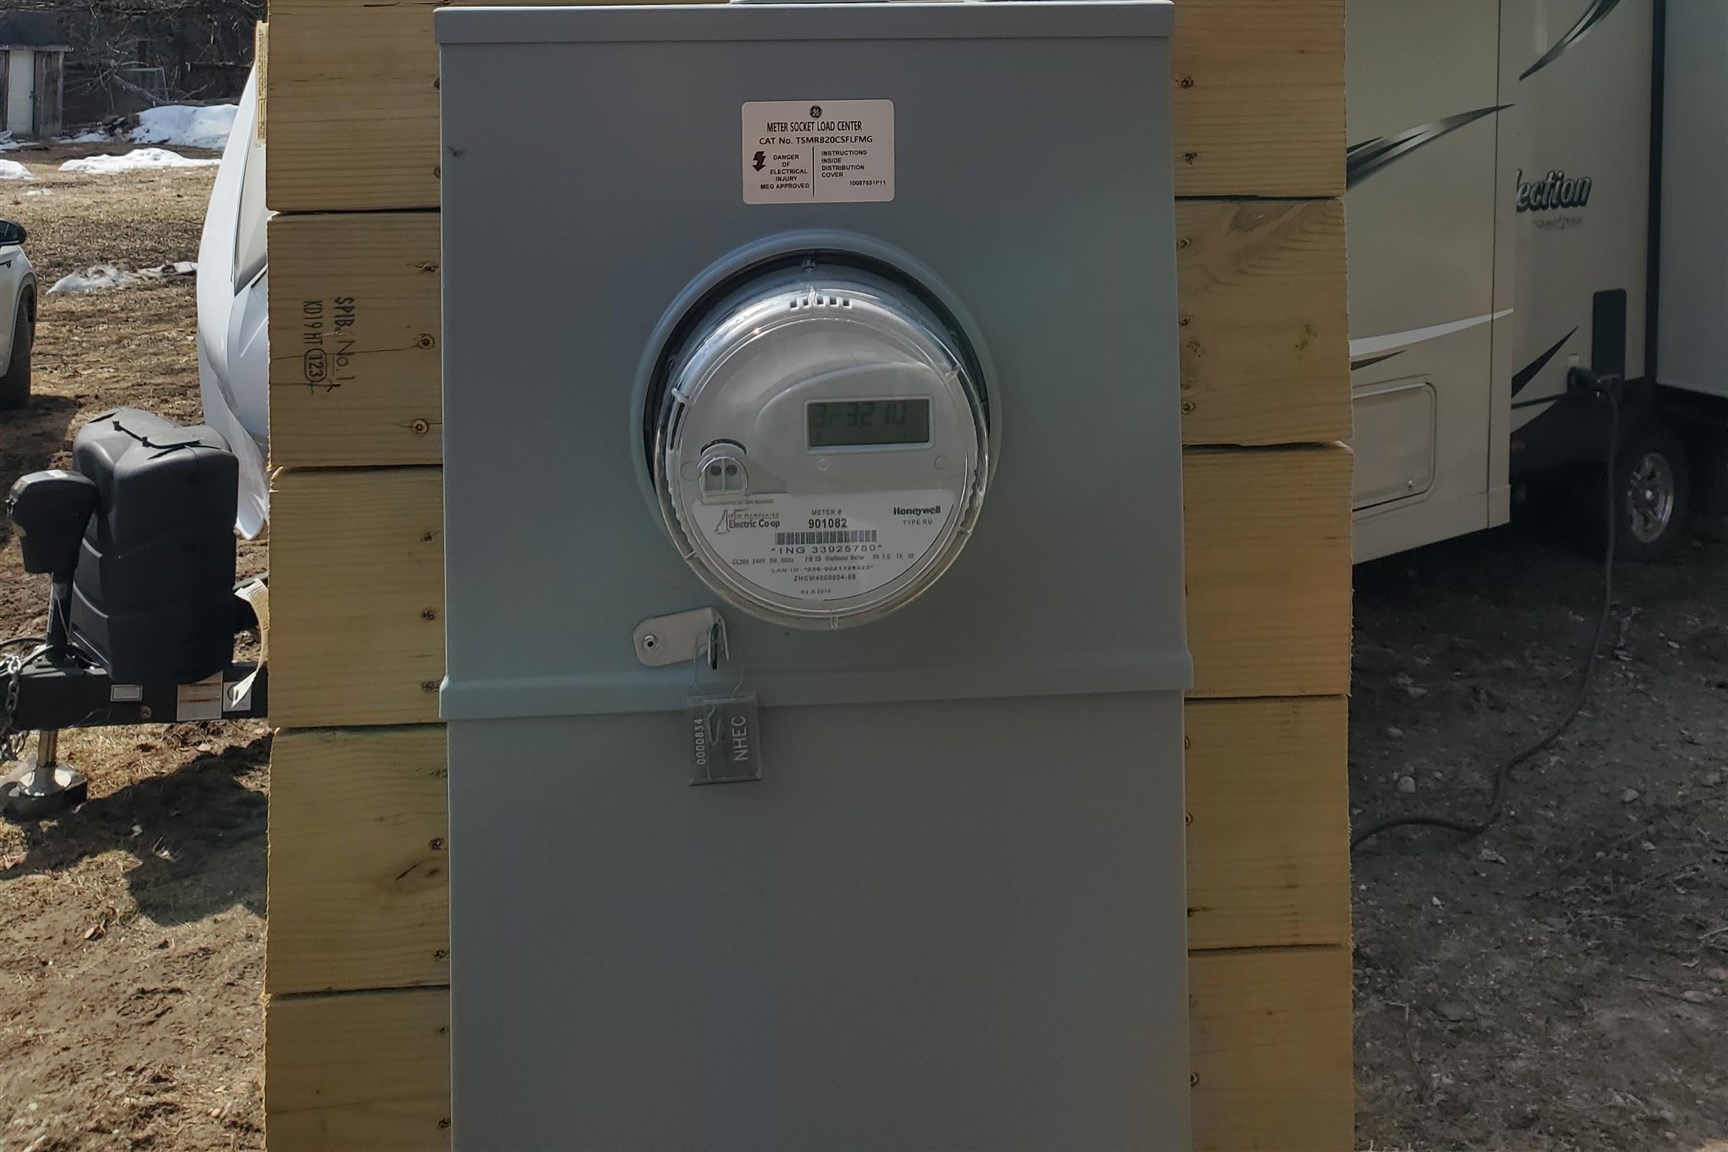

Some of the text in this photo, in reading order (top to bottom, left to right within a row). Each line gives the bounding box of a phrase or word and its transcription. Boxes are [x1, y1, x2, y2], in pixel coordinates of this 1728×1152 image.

[767, 120, 863, 132] METER SOCKET LOAD CENTER
[759, 137, 776, 145] CAT
[779, 137, 793, 145] No.
[308, 353, 324, 378] 123
[893, 505, 941, 516] Honeywell
[729, 518, 757, 529] Electric
[808, 517, 848, 529] 901082
[731, 715, 748, 761] NHEC
